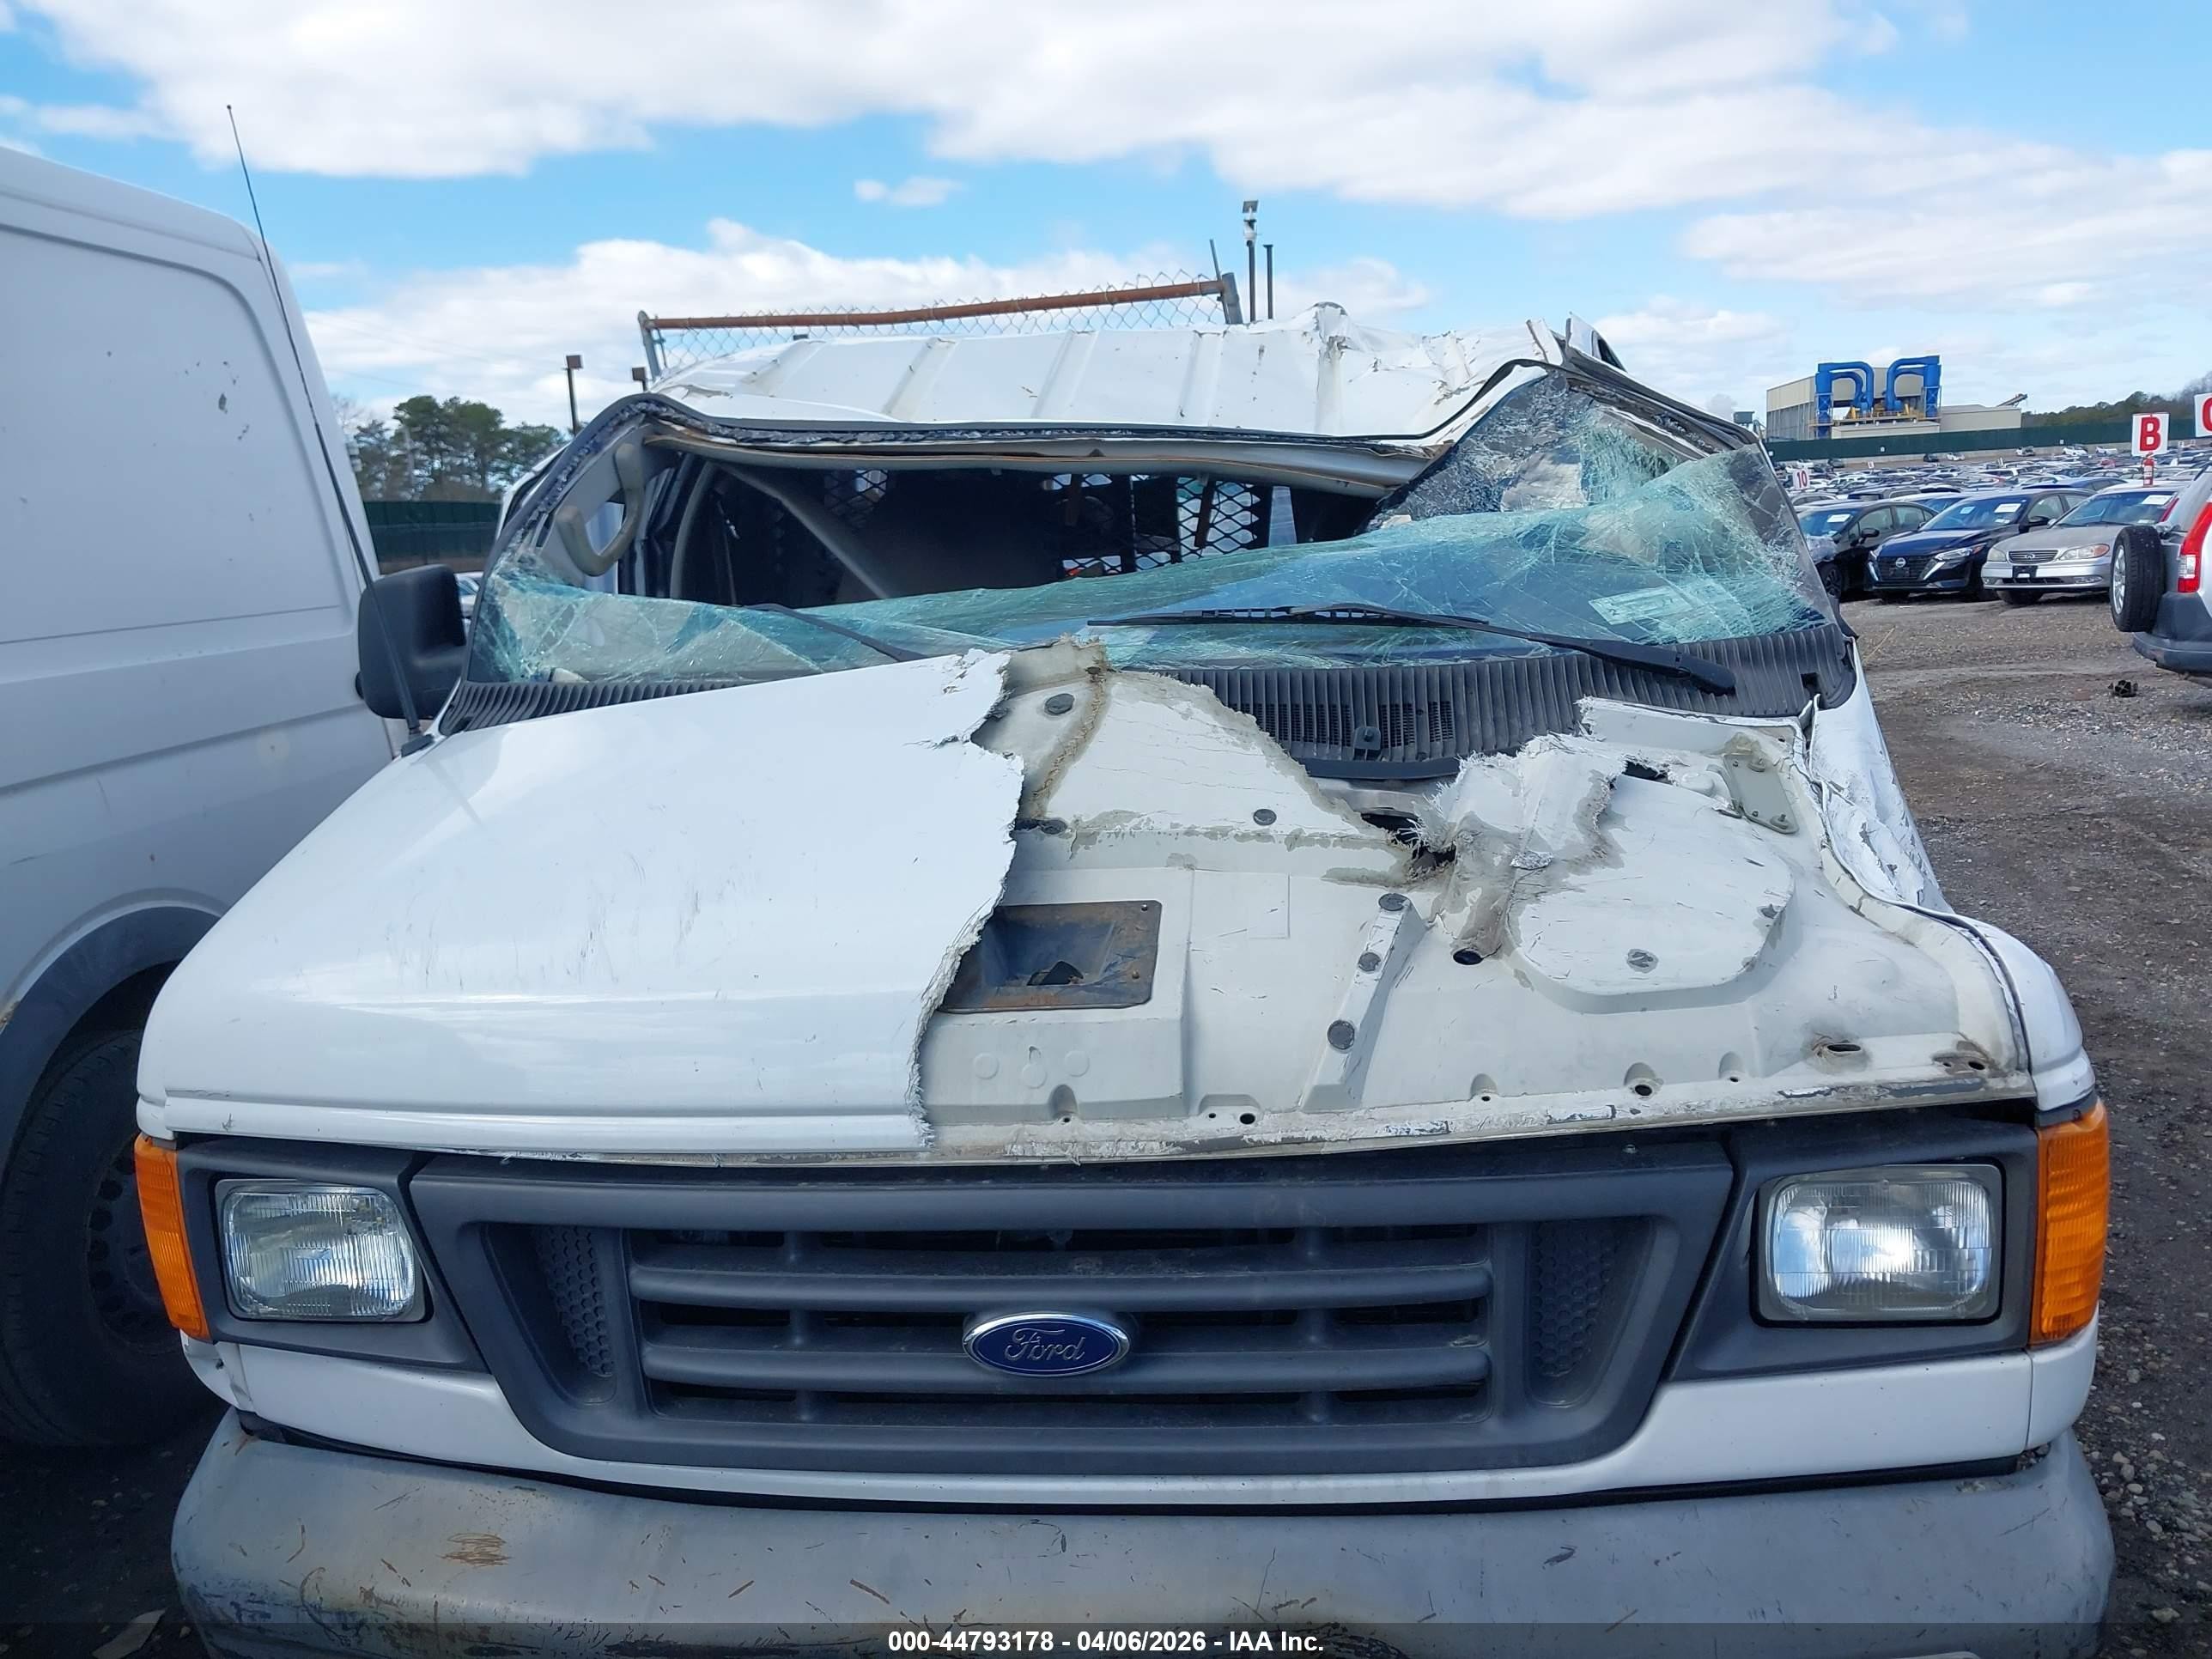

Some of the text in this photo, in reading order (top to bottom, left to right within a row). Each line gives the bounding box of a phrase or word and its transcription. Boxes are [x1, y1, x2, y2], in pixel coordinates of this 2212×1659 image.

[2139, 416, 2161, 452] B
[1796, 470, 1808, 489] 10
[1004, 1328, 1086, 1361] Ford
